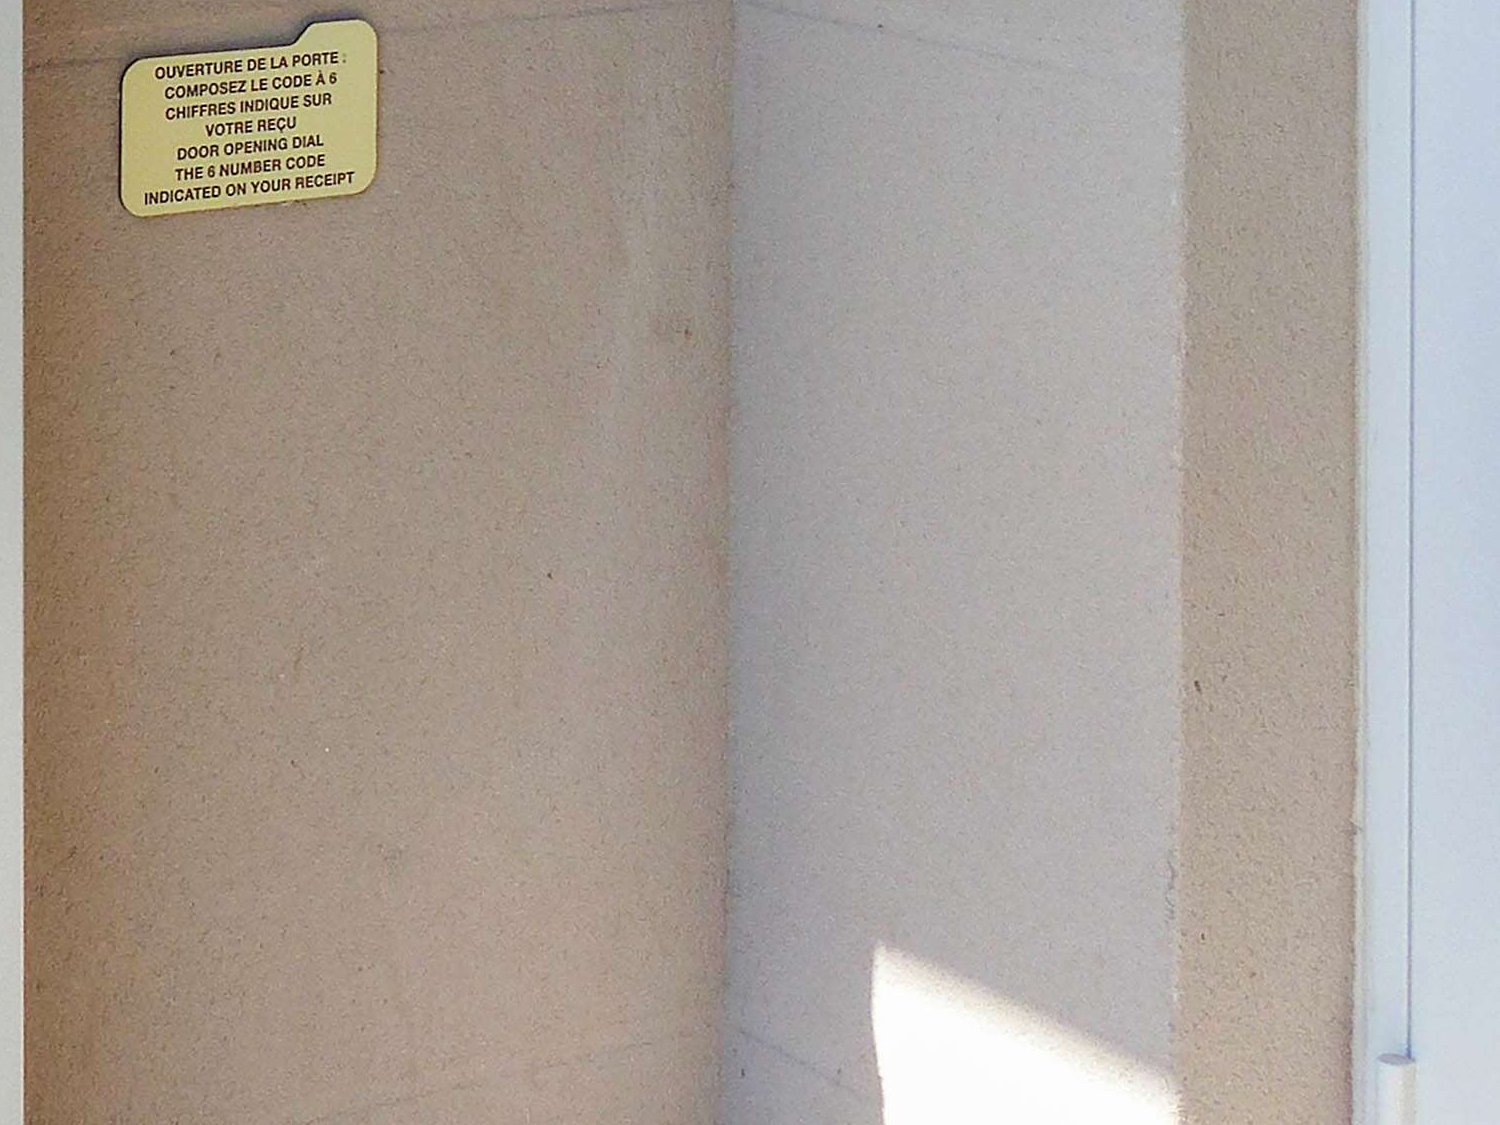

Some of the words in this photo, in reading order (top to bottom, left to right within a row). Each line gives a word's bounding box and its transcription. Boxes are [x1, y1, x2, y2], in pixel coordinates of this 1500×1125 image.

[154, 59, 243, 80] OUVERTURE
[247, 58, 266, 71] DE
[270, 56, 288, 69] LA
[292, 51, 339, 67] PORTE
[164, 80, 247, 100] COMPOSEZ
[251, 78, 268, 92] LE
[272, 73, 312, 90] CODE
[315, 69, 326, 86] À
[328, 72, 338, 84] 6
[165, 101, 237, 121] CHIFFRES
[240, 95, 299, 114] INDIQUE
[303, 92, 333, 108] SUR
[205, 120, 253, 137] VOTRE
[257, 116, 297, 134] REÇU
[176, 145, 219, 161] DOOR
[223, 138, 288, 156] OPENING
[292, 134, 324, 149] DIAL
[175, 166, 203, 182] THE
[207, 165, 216, 178] 6
[219, 158, 282, 177] NUMBER
[286, 154, 326, 171] CODE
[143, 185, 222, 206] INDICATED
[225, 181, 247, 196] ON
[250, 176, 291, 194] YOUR
[295, 171, 355, 189] RECEIPT
